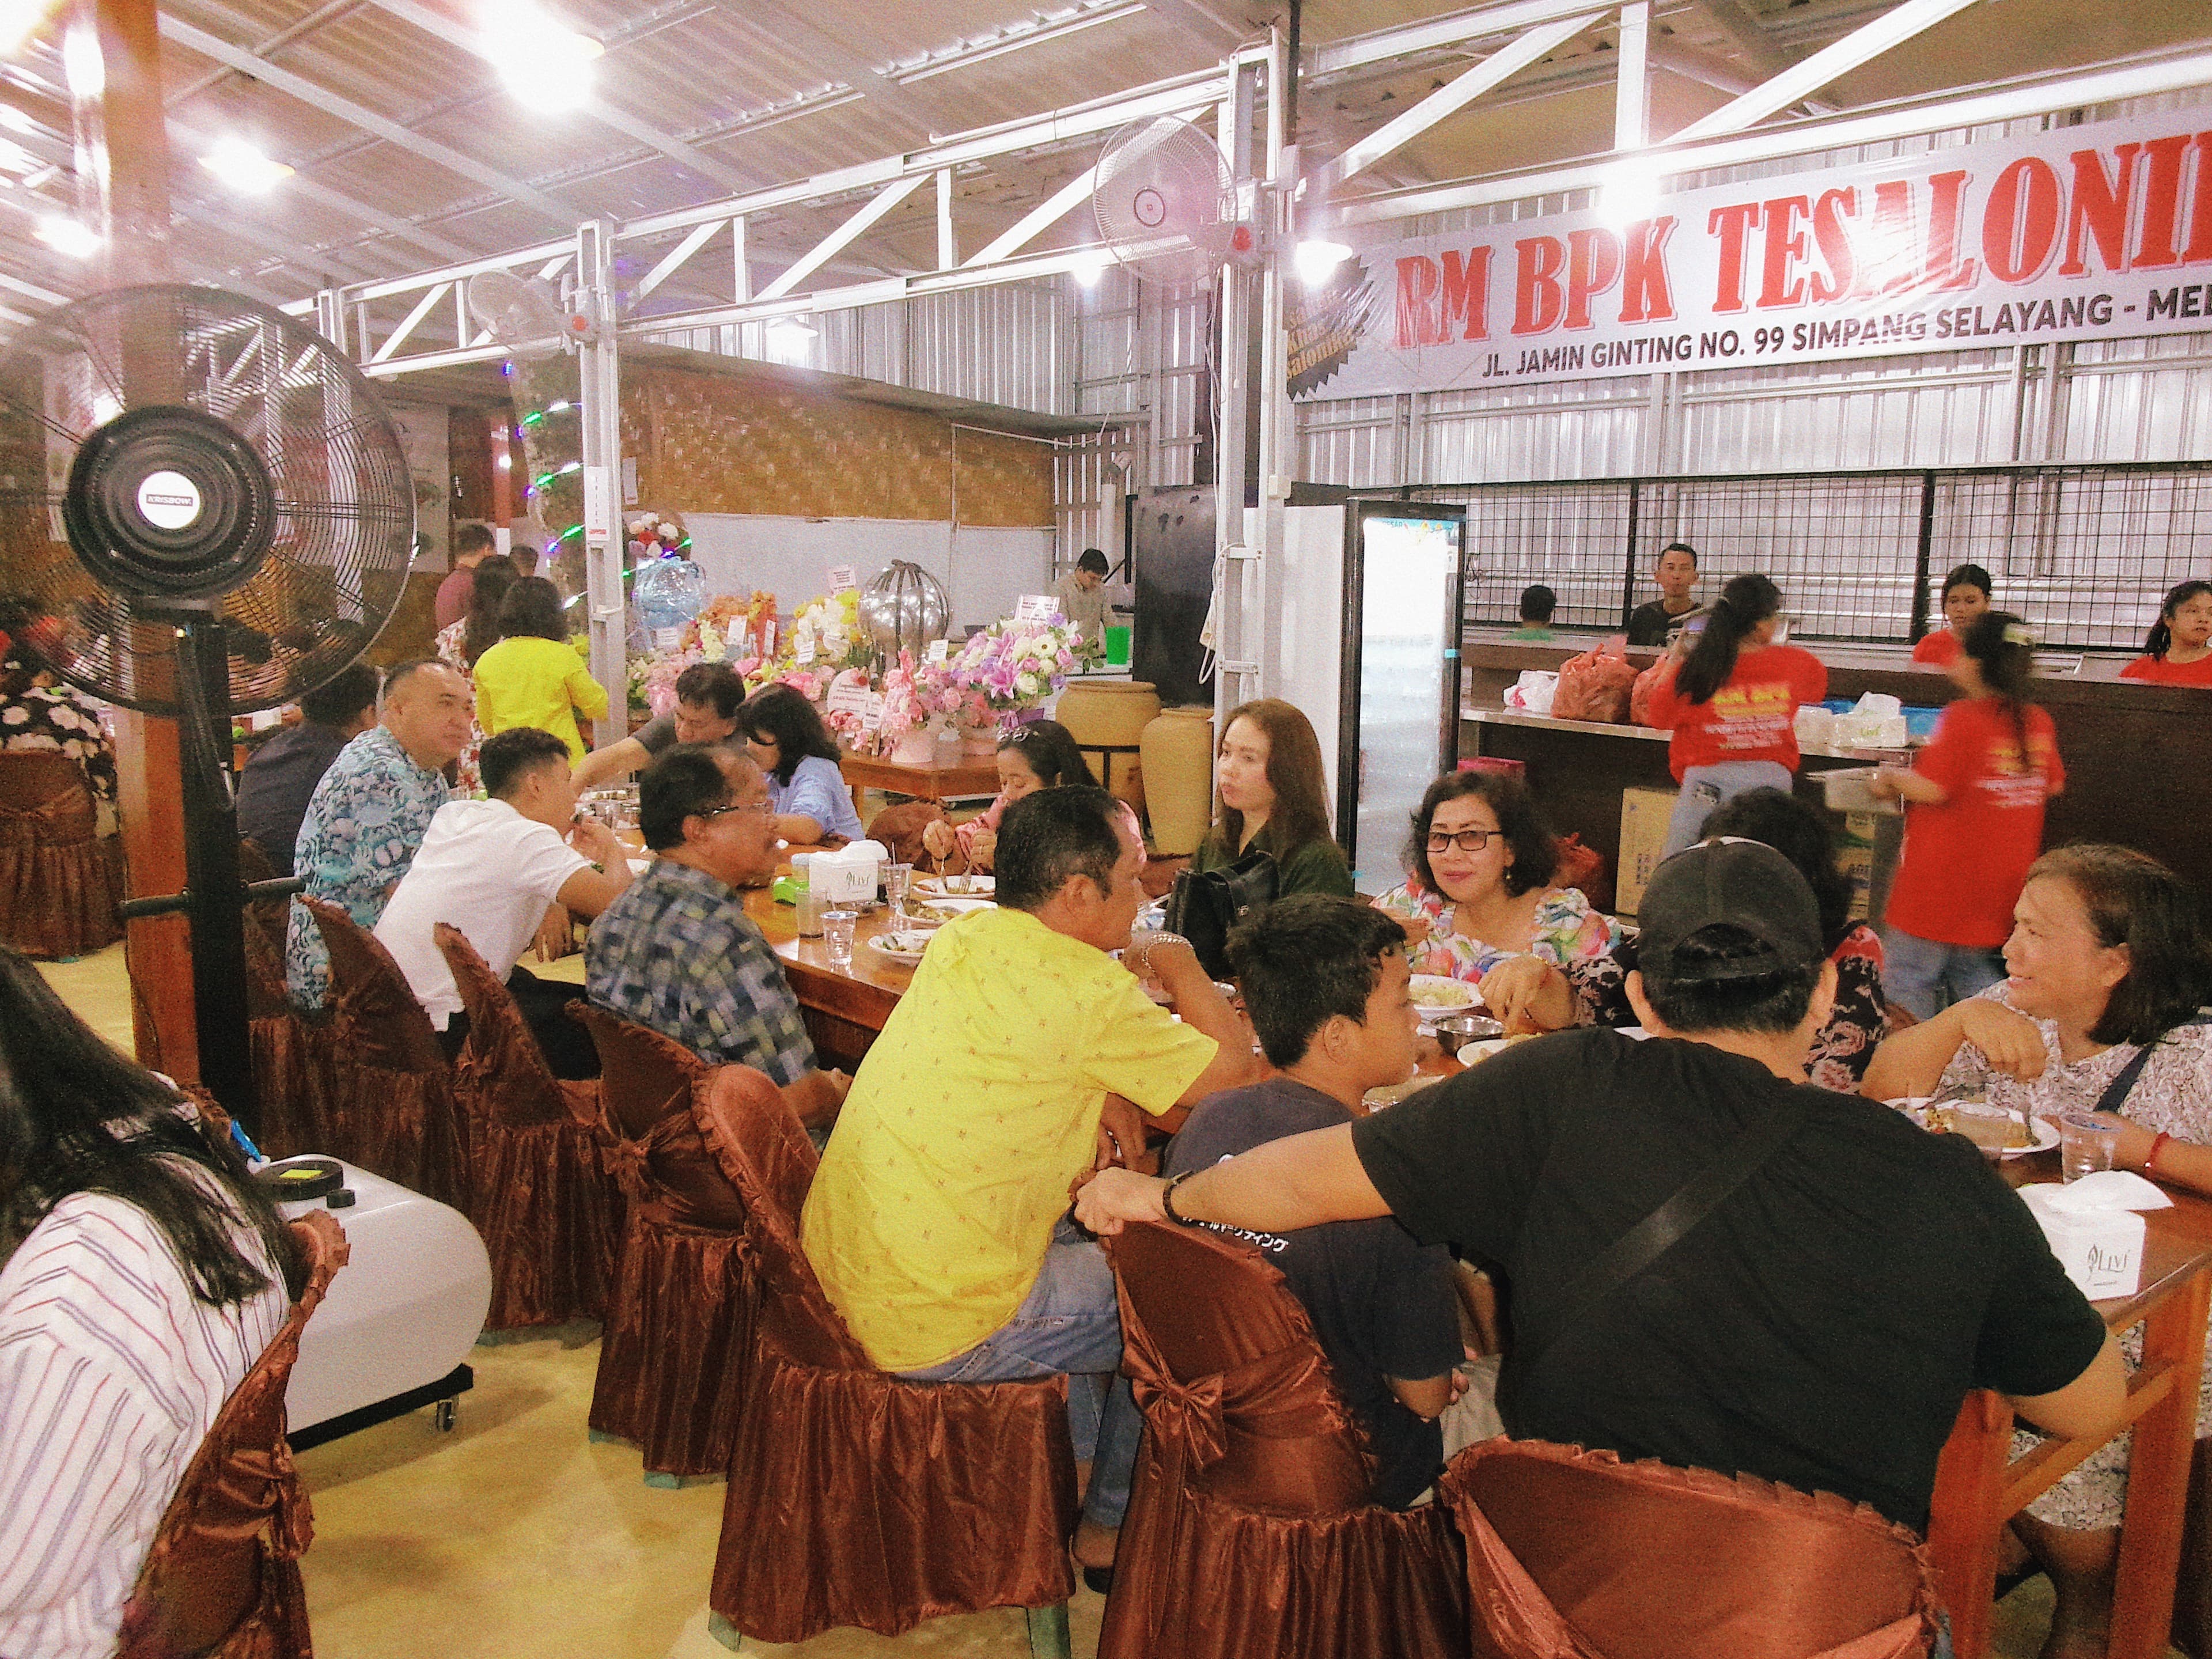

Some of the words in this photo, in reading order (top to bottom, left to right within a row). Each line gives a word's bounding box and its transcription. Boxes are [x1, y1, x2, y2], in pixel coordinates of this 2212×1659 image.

[1393, 245, 1494, 350] RM
[1510, 215, 1679, 338] BPK
[1482, 354, 1509, 378] JL.
[1516, 344, 1584, 375] JAMIN
[1590, 334, 1692, 368] GINTING
[1699, 329, 1744, 360] NO.
[1756, 327, 1785, 354] 99
[1791, 312, 1927, 351] SIMPANG
[1936, 293, 2113, 339] SELAYANG
